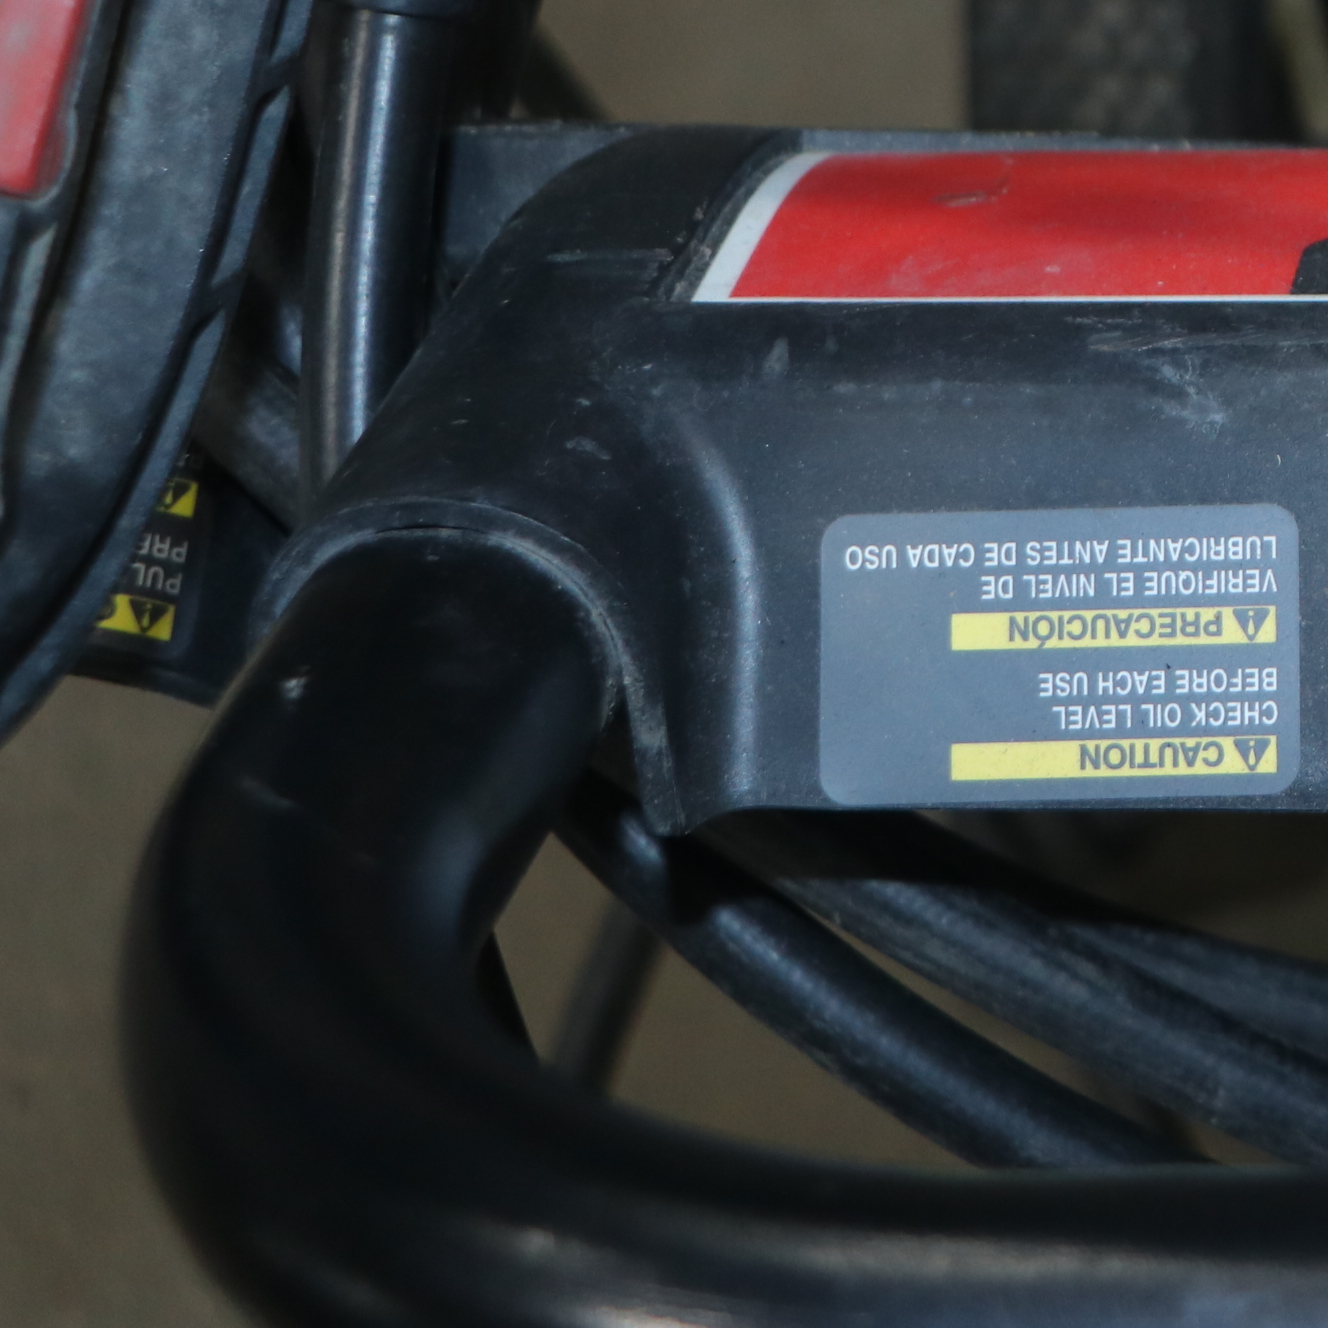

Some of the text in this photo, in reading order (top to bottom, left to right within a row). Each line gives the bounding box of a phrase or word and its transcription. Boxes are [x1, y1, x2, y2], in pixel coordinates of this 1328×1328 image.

[135, 532, 188, 563] PRE
[845, 535, 1277, 570] LUBRICANTE ANTES DE CADA USO
[130, 562, 182, 594] PUL
[980, 567, 1277, 600] VERIFIQUE EL NIVEL DE
[1008, 610, 1222, 648] PRECAUCIÓN
[1038, 666, 1277, 697] BEFORE EACH USE
[1052, 700, 1278, 730] CHECK OIL LEVEL
[1079, 740, 1224, 771] CAUTION
